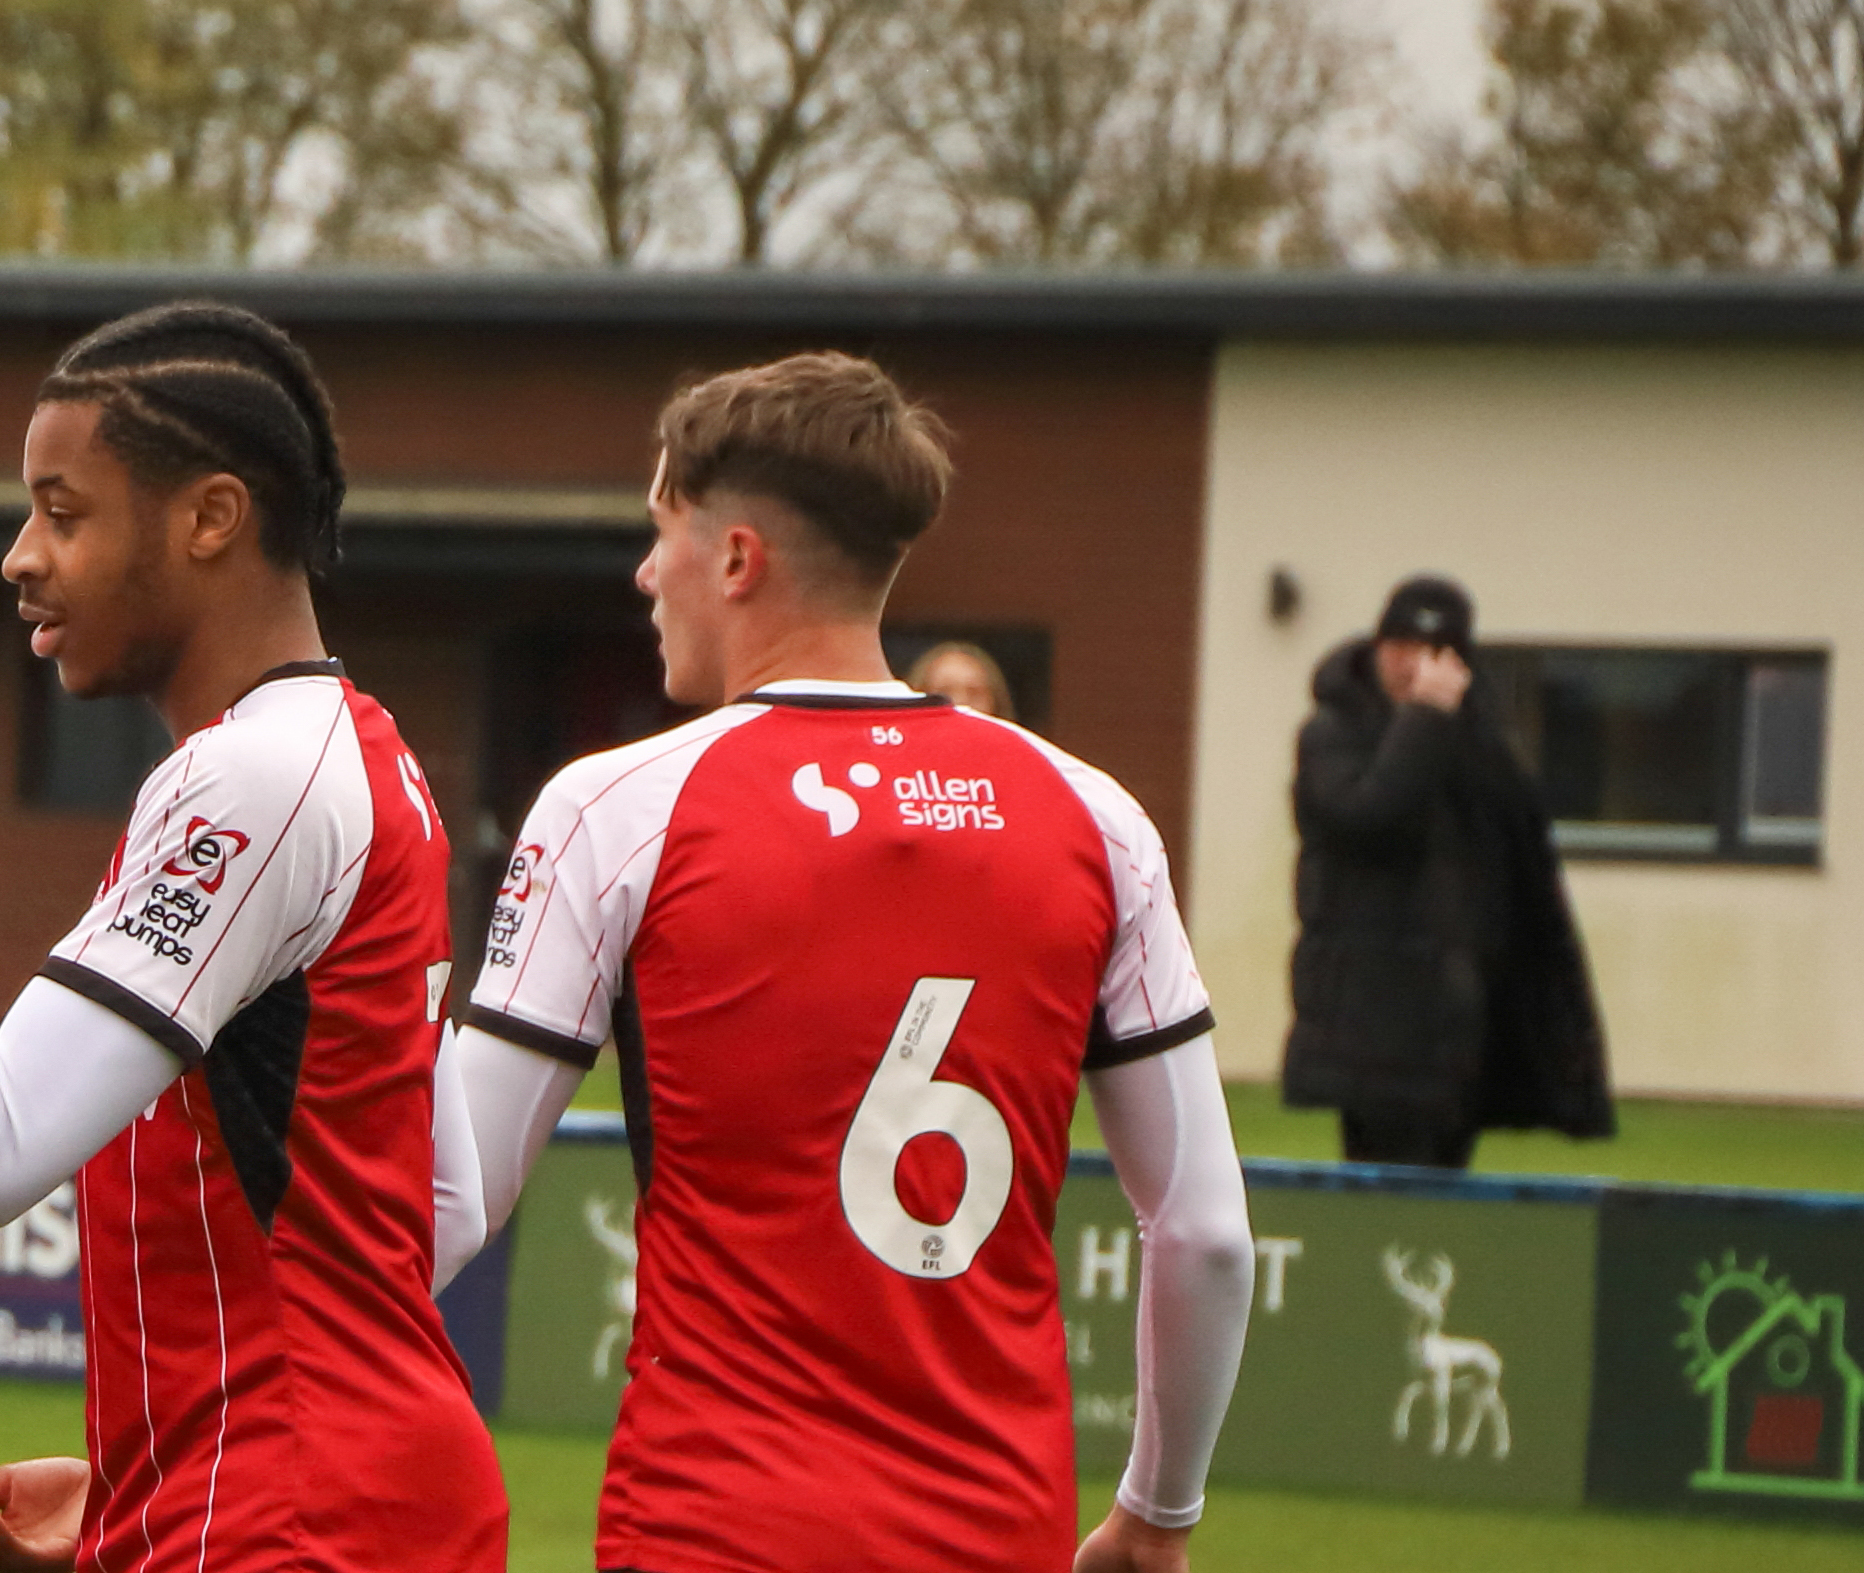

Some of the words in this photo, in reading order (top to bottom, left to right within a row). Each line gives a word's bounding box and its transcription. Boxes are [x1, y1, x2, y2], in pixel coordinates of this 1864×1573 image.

[872, 726, 904, 745] 56
[893, 770, 995, 802] allen
[898, 802, 1005, 831] signs
[151, 883, 211, 928] easy
[839, 977, 1014, 1279] 6
[922, 1259, 941, 1271] EFL
